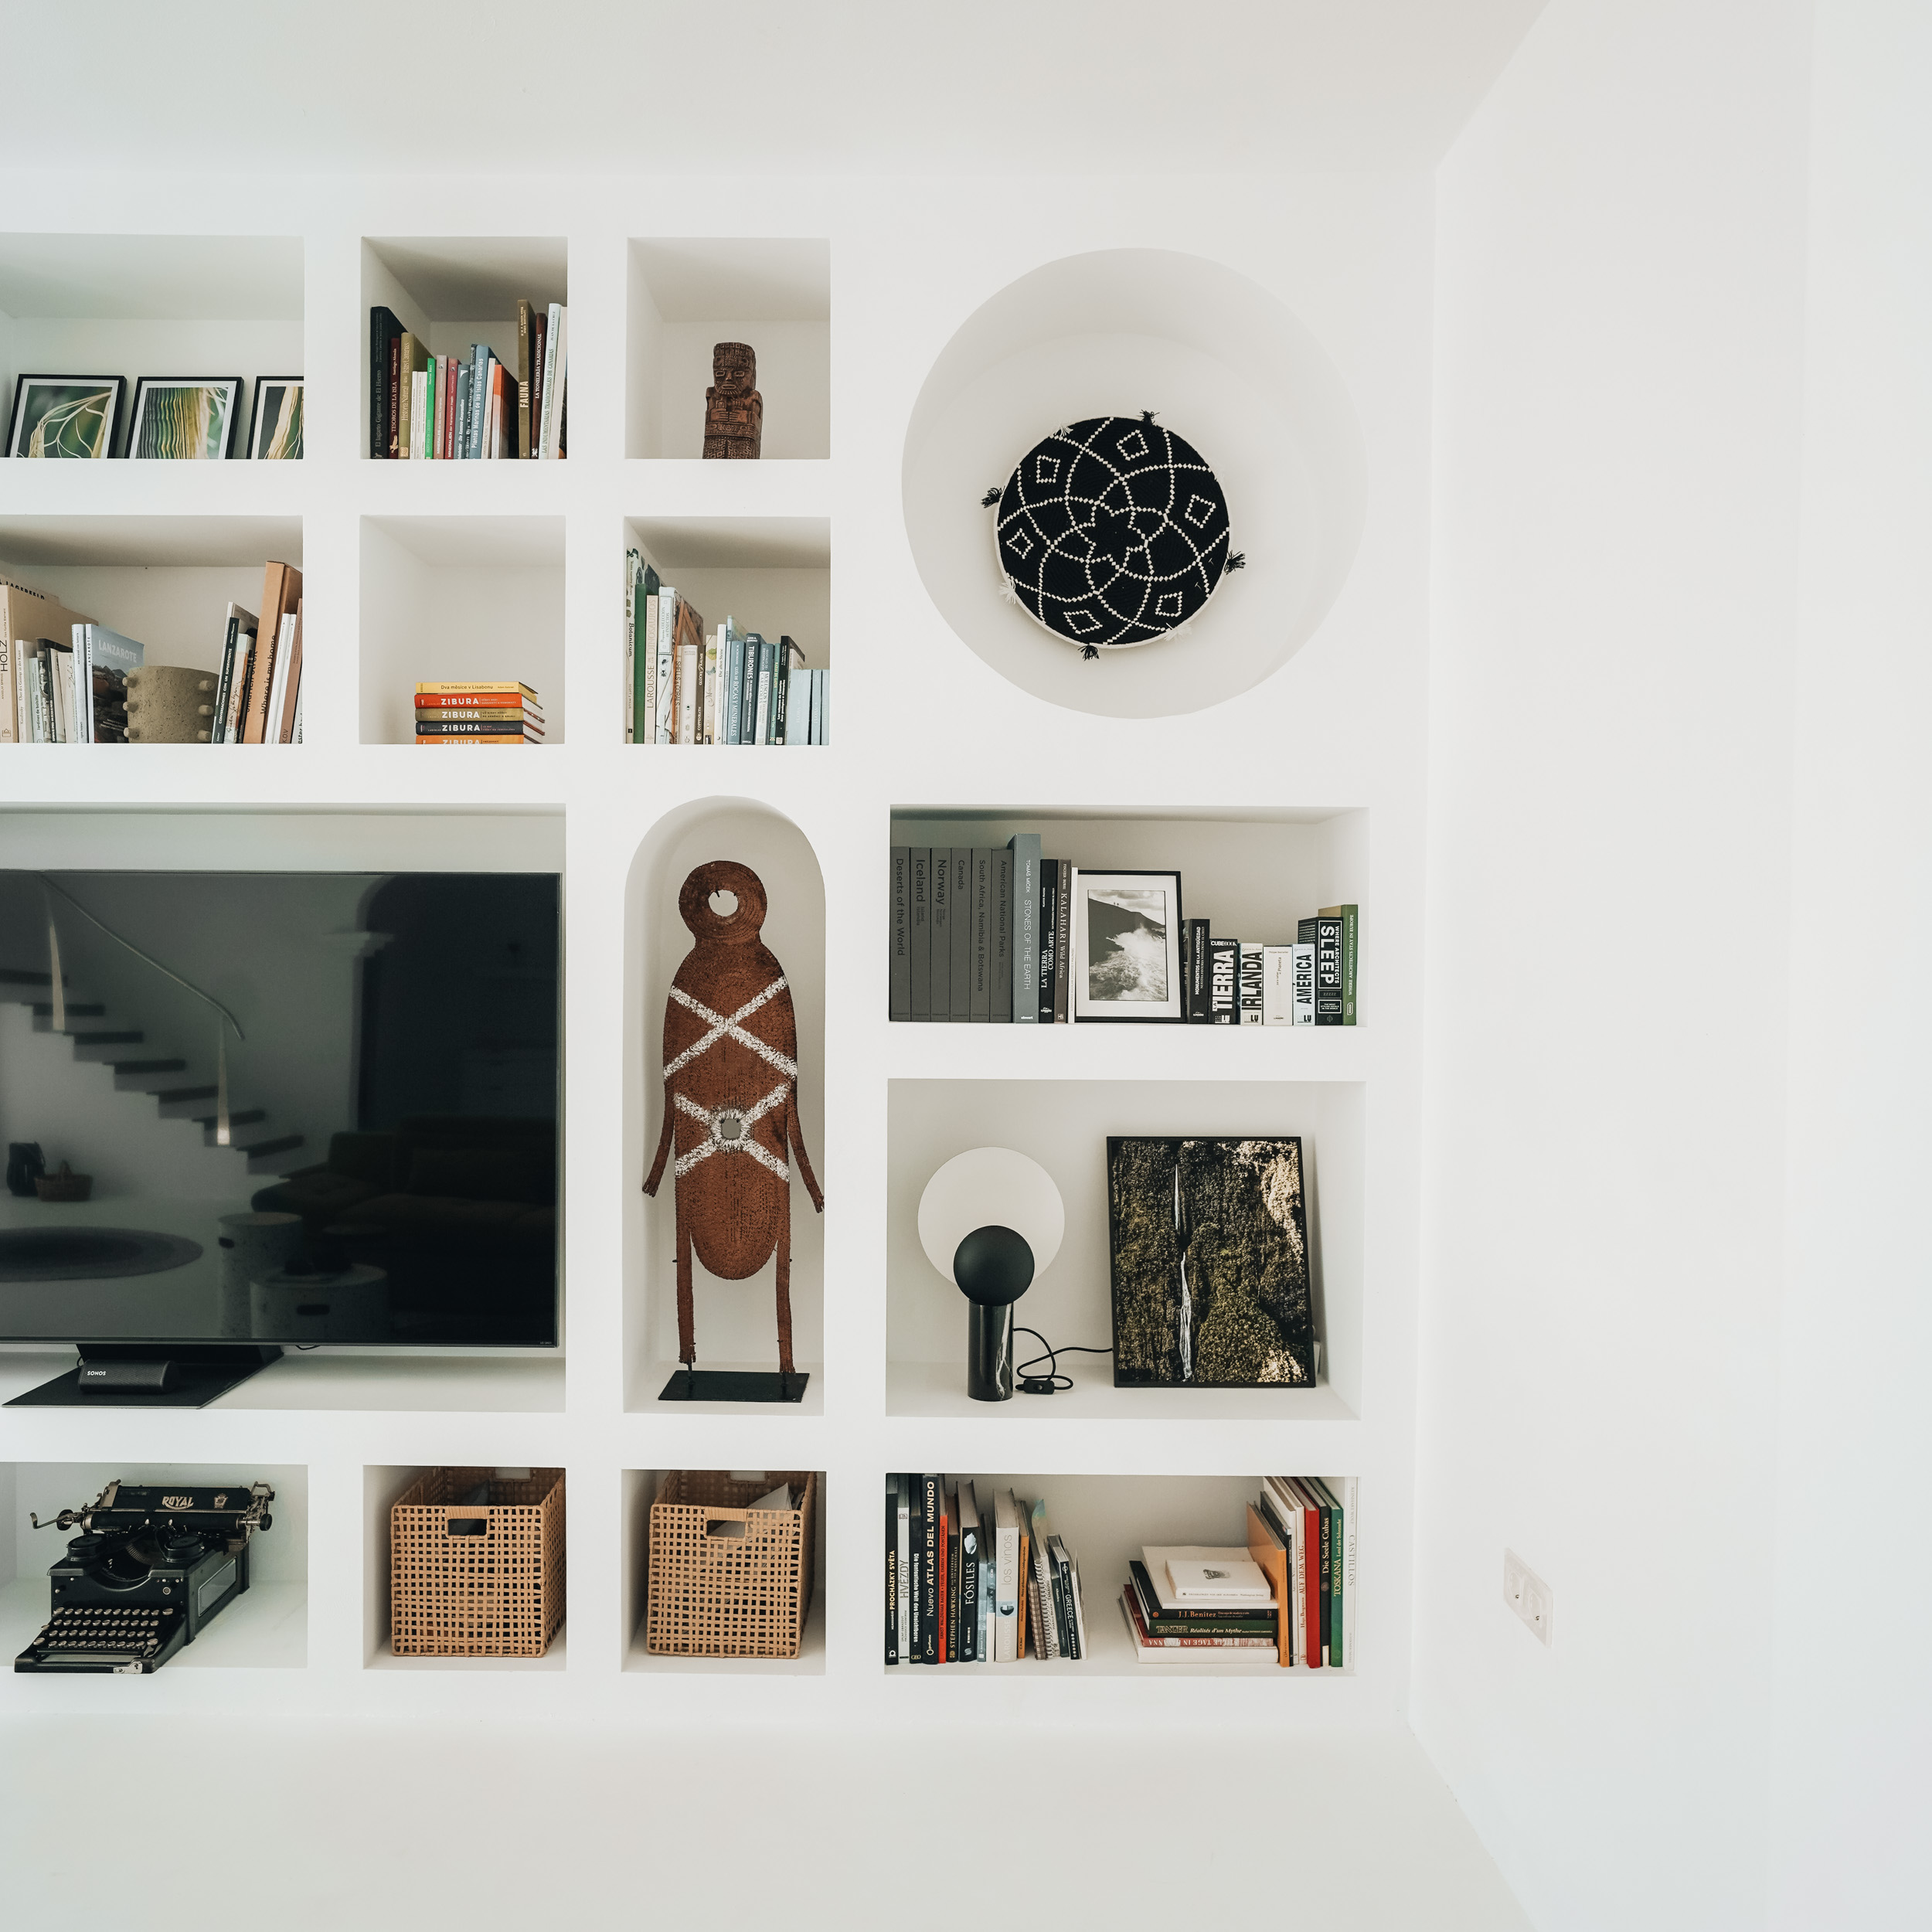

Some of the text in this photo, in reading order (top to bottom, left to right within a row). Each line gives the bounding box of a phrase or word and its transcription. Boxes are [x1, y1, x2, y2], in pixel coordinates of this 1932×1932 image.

[519, 381, 529, 408] FAUNA
[647, 600, 655, 655] DINOSAURIOS
[99, 639, 137, 663] LANZAROTE
[916, 859, 926, 902] Iceland
[935, 859, 947, 905] Norway
[978, 885, 986, 909] Africa,
[896, 896, 904, 906] of
[1024, 934, 1031, 944] OF
[1320, 926, 1335, 984] SLEEP
[1042, 978, 1047, 988] LA
[1212, 950, 1233, 1011] TIERRA
[1241, 952, 1262, 1011] IRLANDA
[1294, 954, 1312, 1005] AMÉRICA
[162, 1496, 193, 1509] ROYAL
[898, 1560, 909, 1598] HVĚZDY
[1002, 1535, 1012, 1584] los vinos
[964, 1563, 975, 1604] FÓSILES
[1065, 1594, 1074, 1620] GREECE
